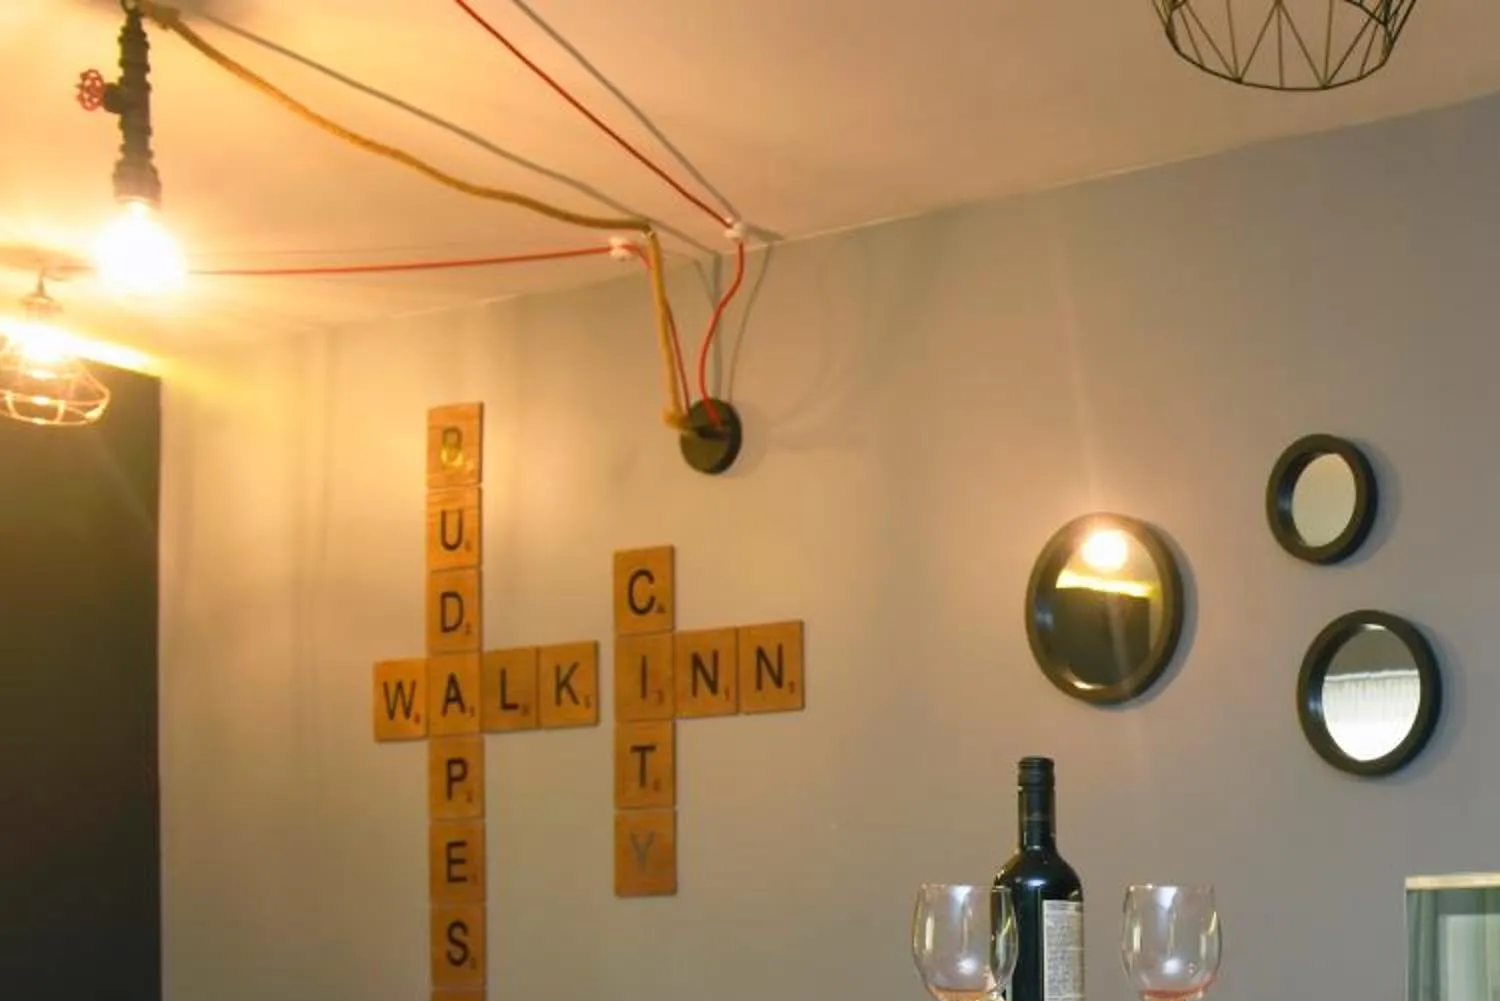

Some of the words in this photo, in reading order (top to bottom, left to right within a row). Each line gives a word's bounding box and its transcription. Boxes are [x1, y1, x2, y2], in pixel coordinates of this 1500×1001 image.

[381, 660, 586, 721] WALK
[639, 643, 789, 701] INN
[624, 566, 660, 879] CITY
